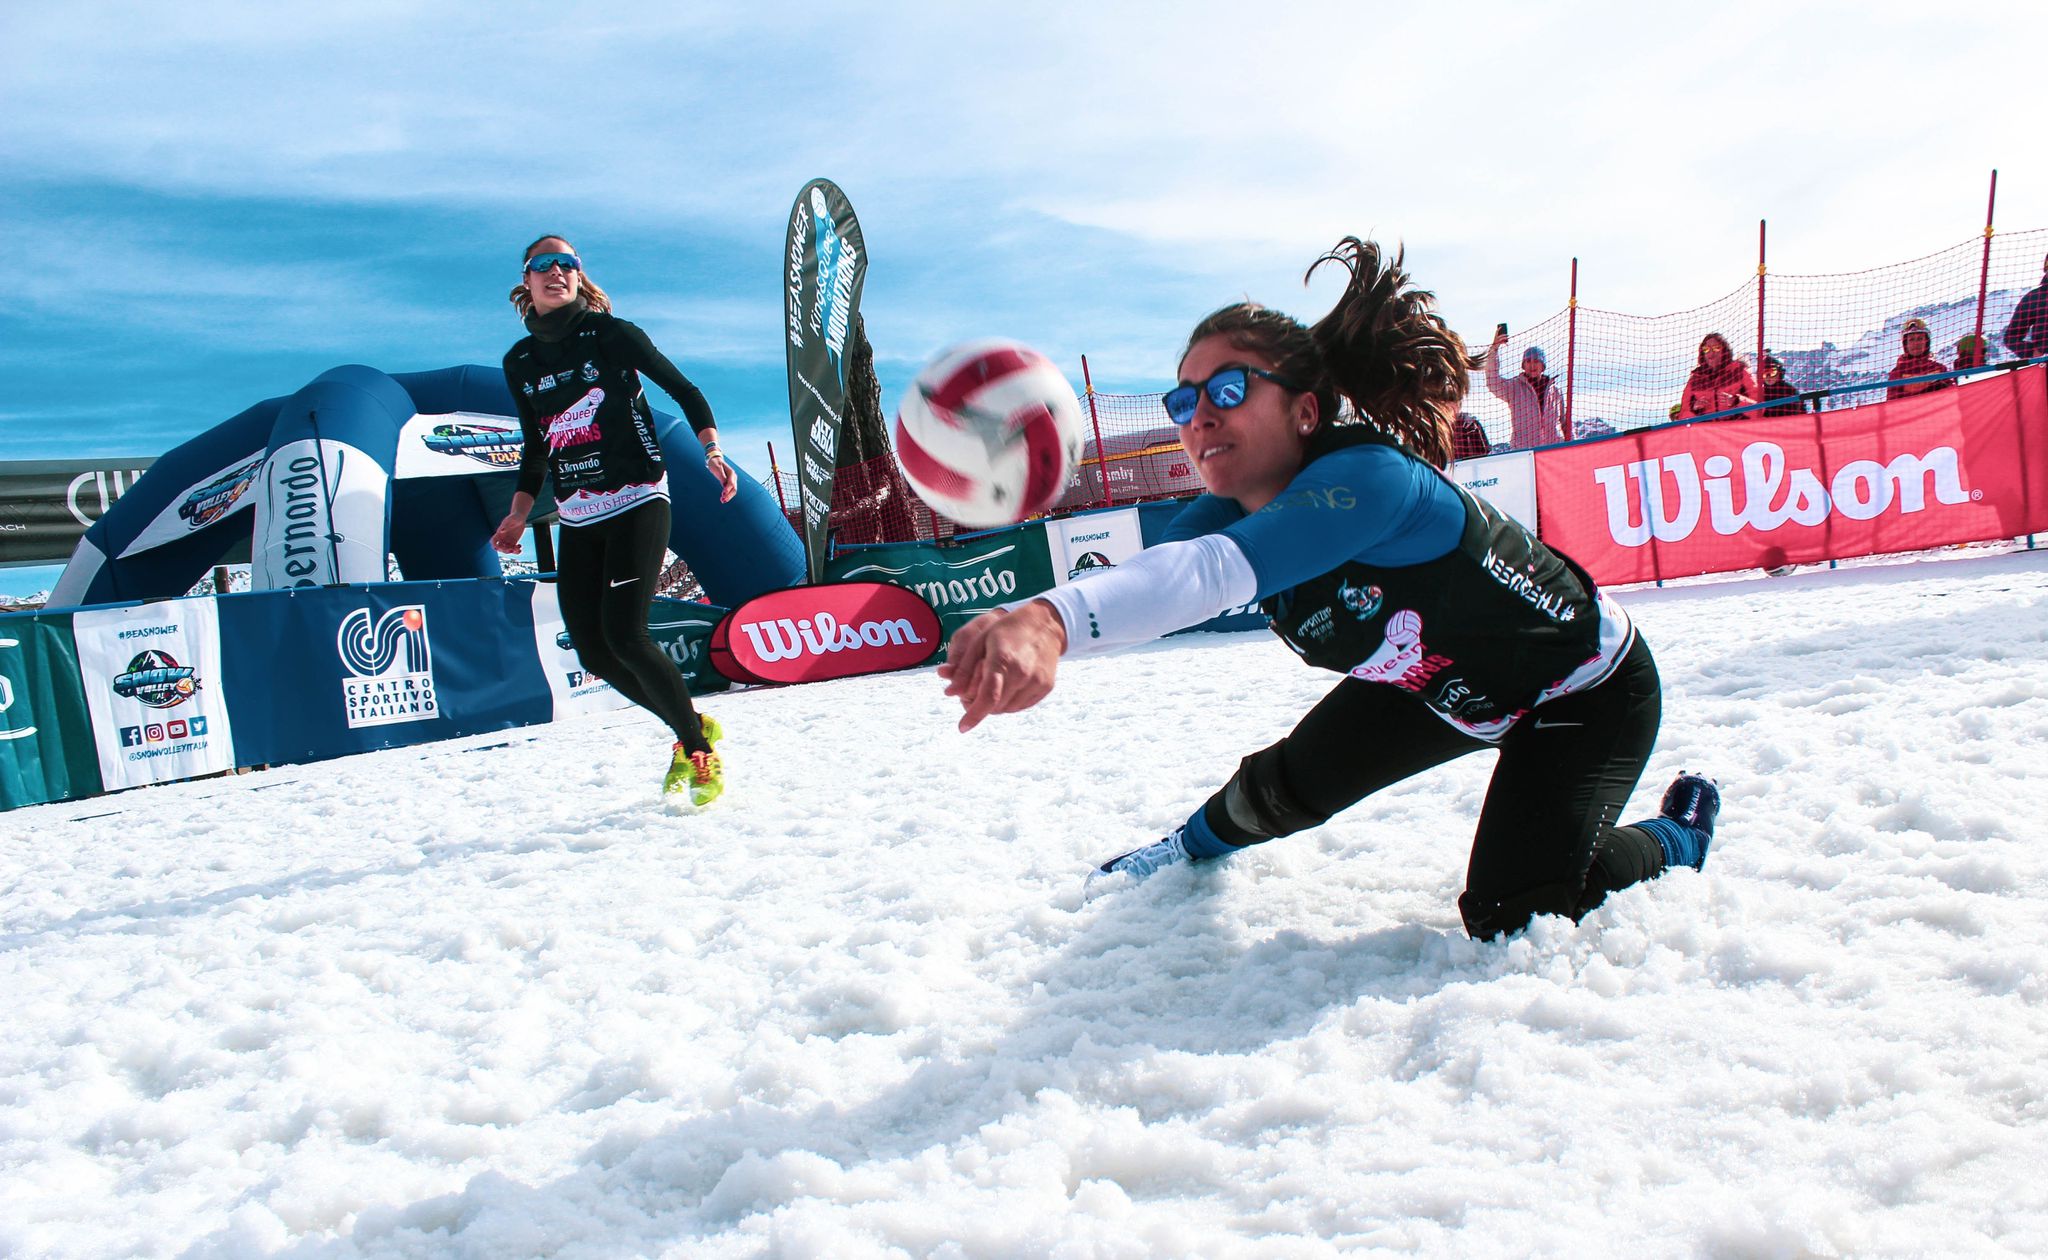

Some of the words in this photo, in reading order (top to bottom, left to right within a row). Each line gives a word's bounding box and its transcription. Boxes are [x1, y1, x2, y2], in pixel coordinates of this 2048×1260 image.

[790, 202, 810, 349] #BEASNOWER
[809, 218, 836, 337] King&Queen
[825, 236, 857, 360] MOUNTAINS
[1594, 441, 1971, 548] Wilson
[280, 456, 319, 589] ernardo
[1071, 531, 1110, 543] #BEASNOWER
[118, 625, 179, 640] #BEASNOWER
[741, 612, 921, 663] Wilson
[114, 667, 195, 688] SNOW
[348, 678, 430, 696] CENTRO
[136, 683, 177, 695] VOLLEY
[349, 690, 432, 707] SPORTIVO
[350, 701, 435, 719] ITALIANO
[129, 741, 209, 761] @SNOWVOLLEYITALIA
